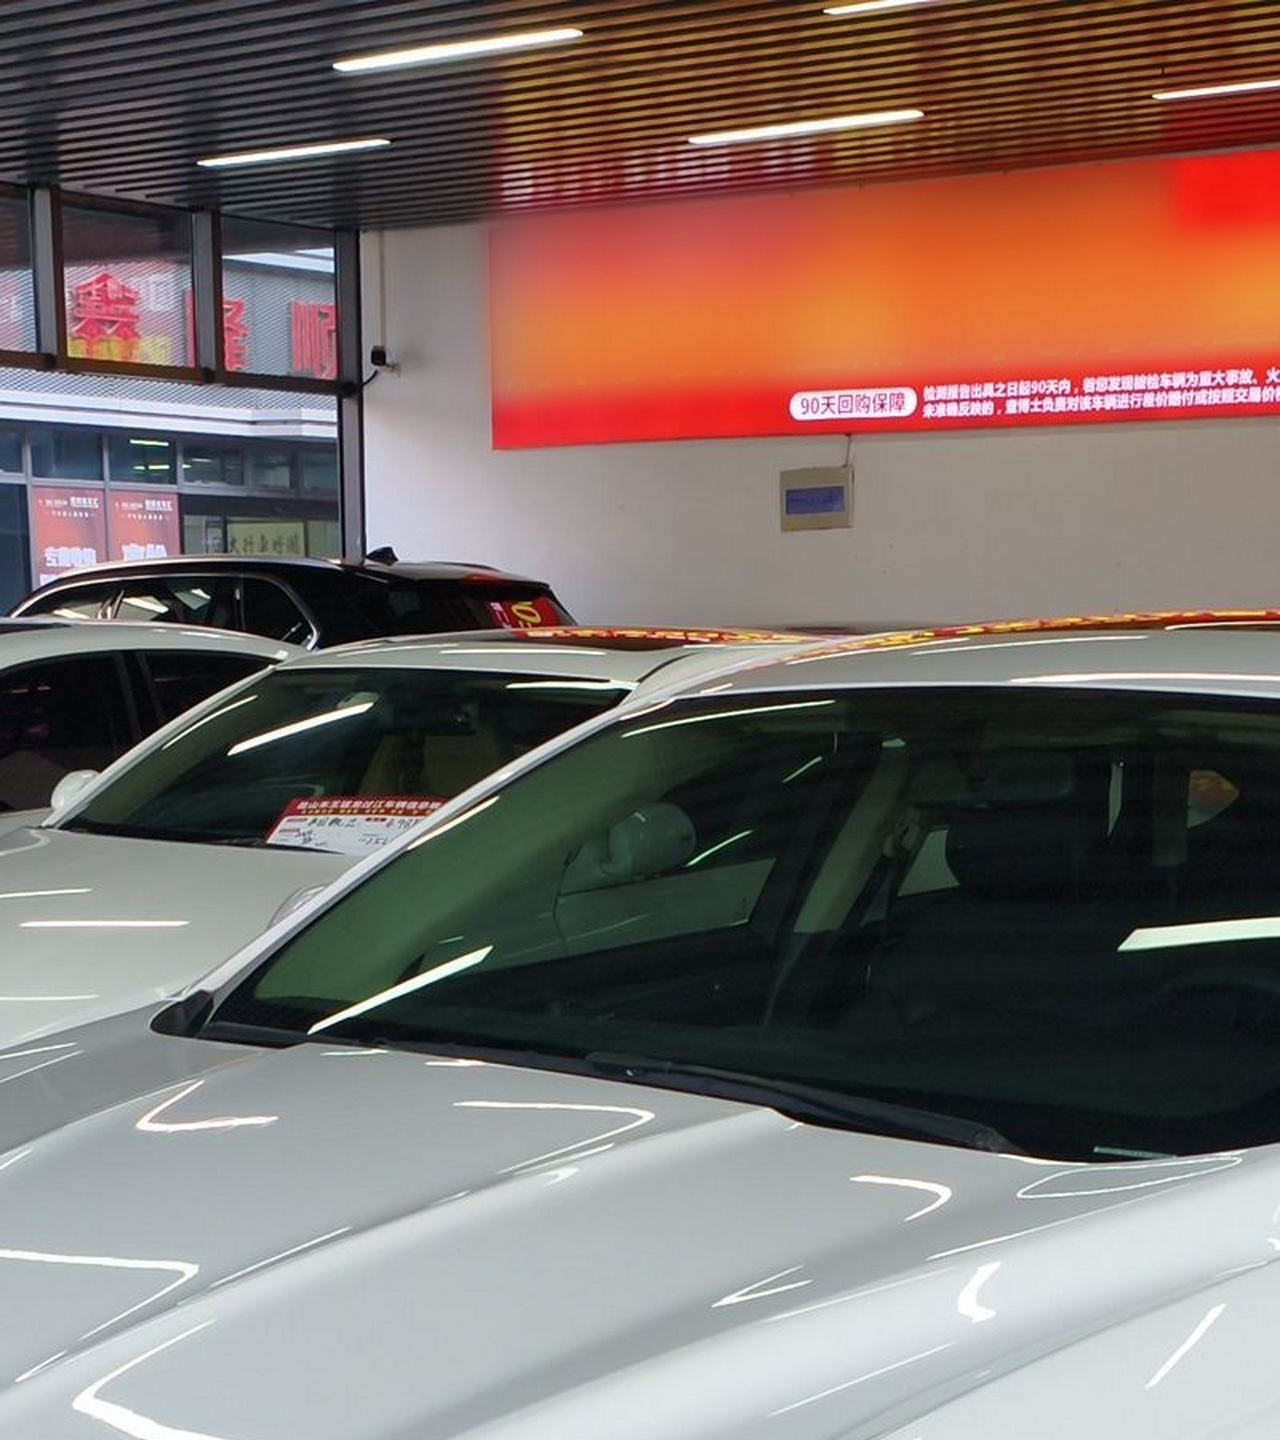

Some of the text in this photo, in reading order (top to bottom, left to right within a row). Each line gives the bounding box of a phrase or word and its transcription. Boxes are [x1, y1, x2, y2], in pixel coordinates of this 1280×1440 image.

[800, 391, 907, 416] 90天回购保障
